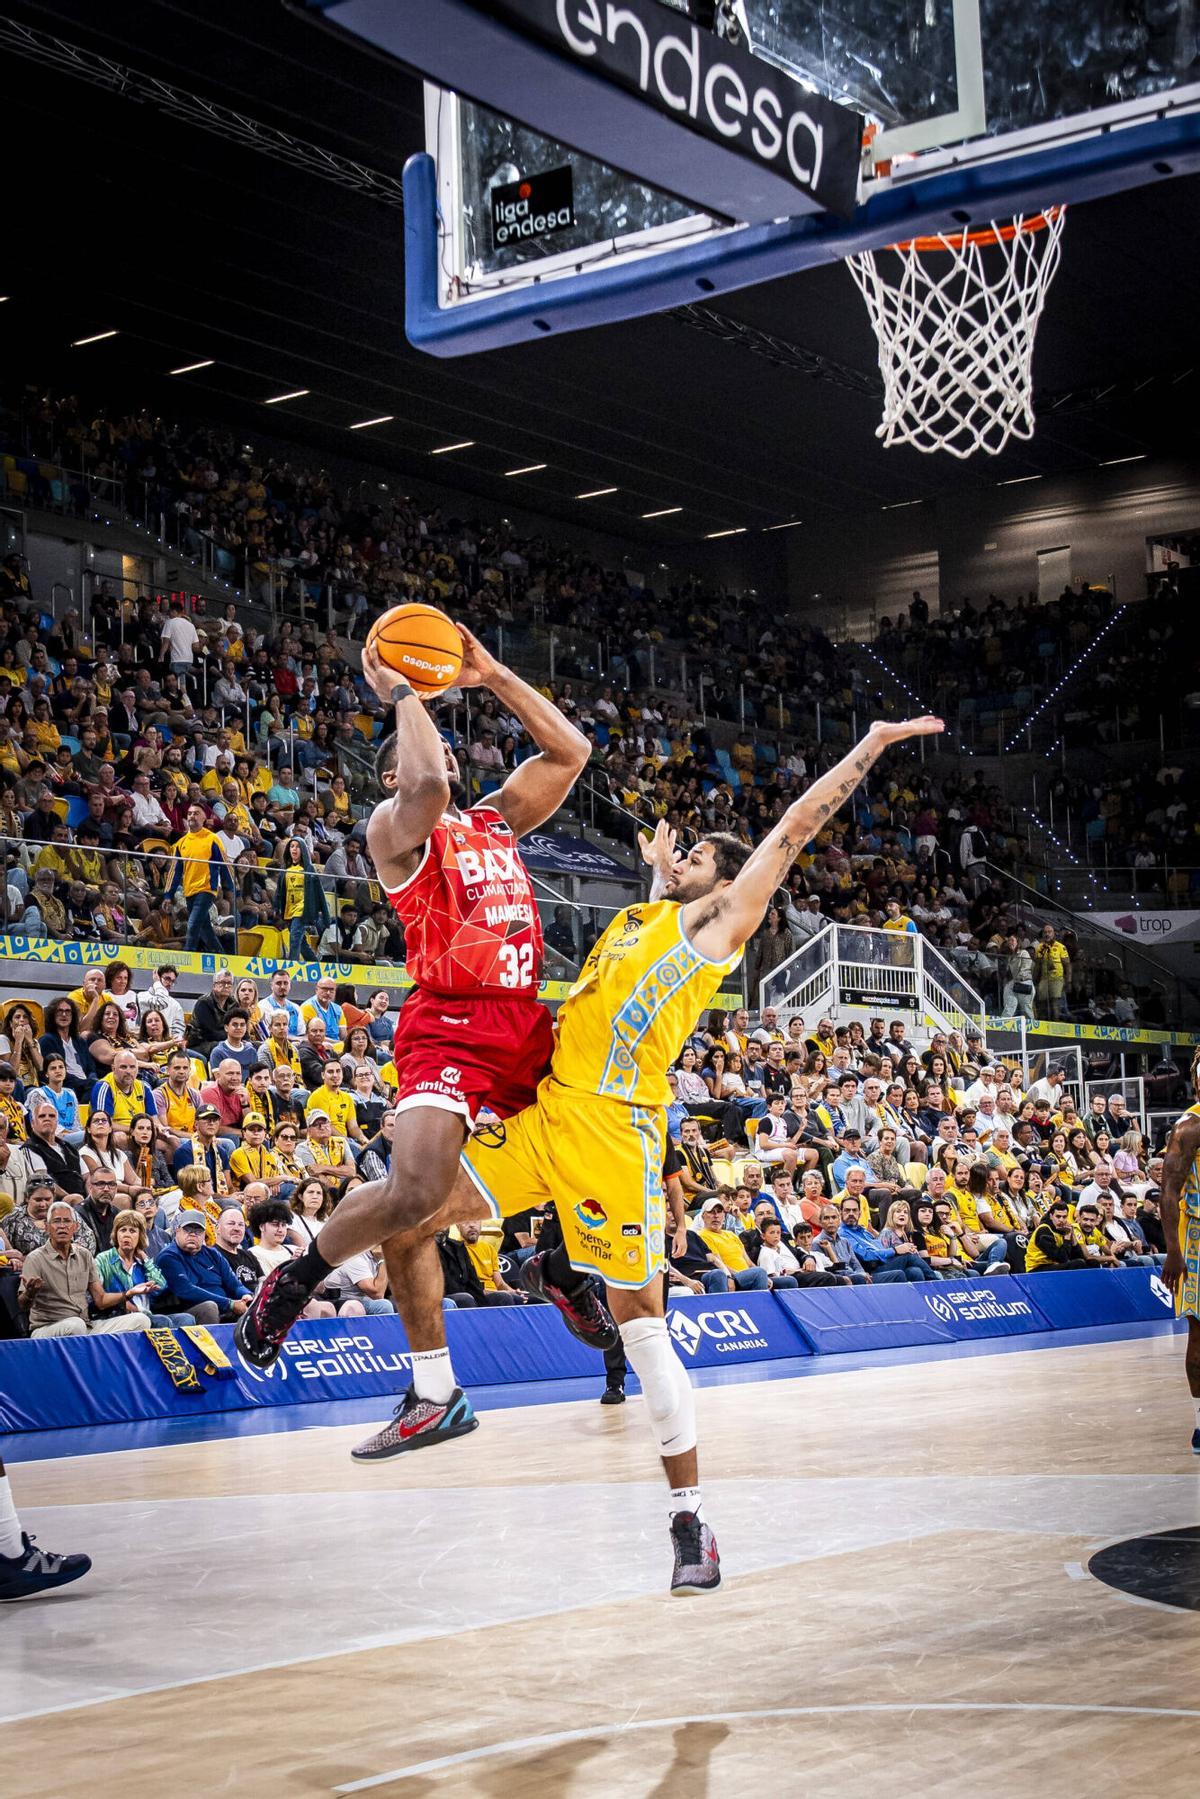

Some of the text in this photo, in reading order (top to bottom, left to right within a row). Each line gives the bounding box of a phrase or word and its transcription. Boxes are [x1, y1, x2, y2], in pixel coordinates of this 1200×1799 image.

[556, 0, 823, 191] endesa
[495, 199, 529, 223] liga
[496, 206, 570, 243] endesa
[1140, 916, 1172, 935] trop
[499, 943, 534, 989] 32
[623, 1227, 638, 1236] acb
[590, 1245, 613, 1261] Mar
[946, 1289, 997, 1304] GRUPO
[959, 1301, 1032, 1321] solitium
[697, 1308, 760, 1339] CRI
[283, 1336, 375, 1357] GRUPO
[715, 1338, 769, 1352] CANARIAS
